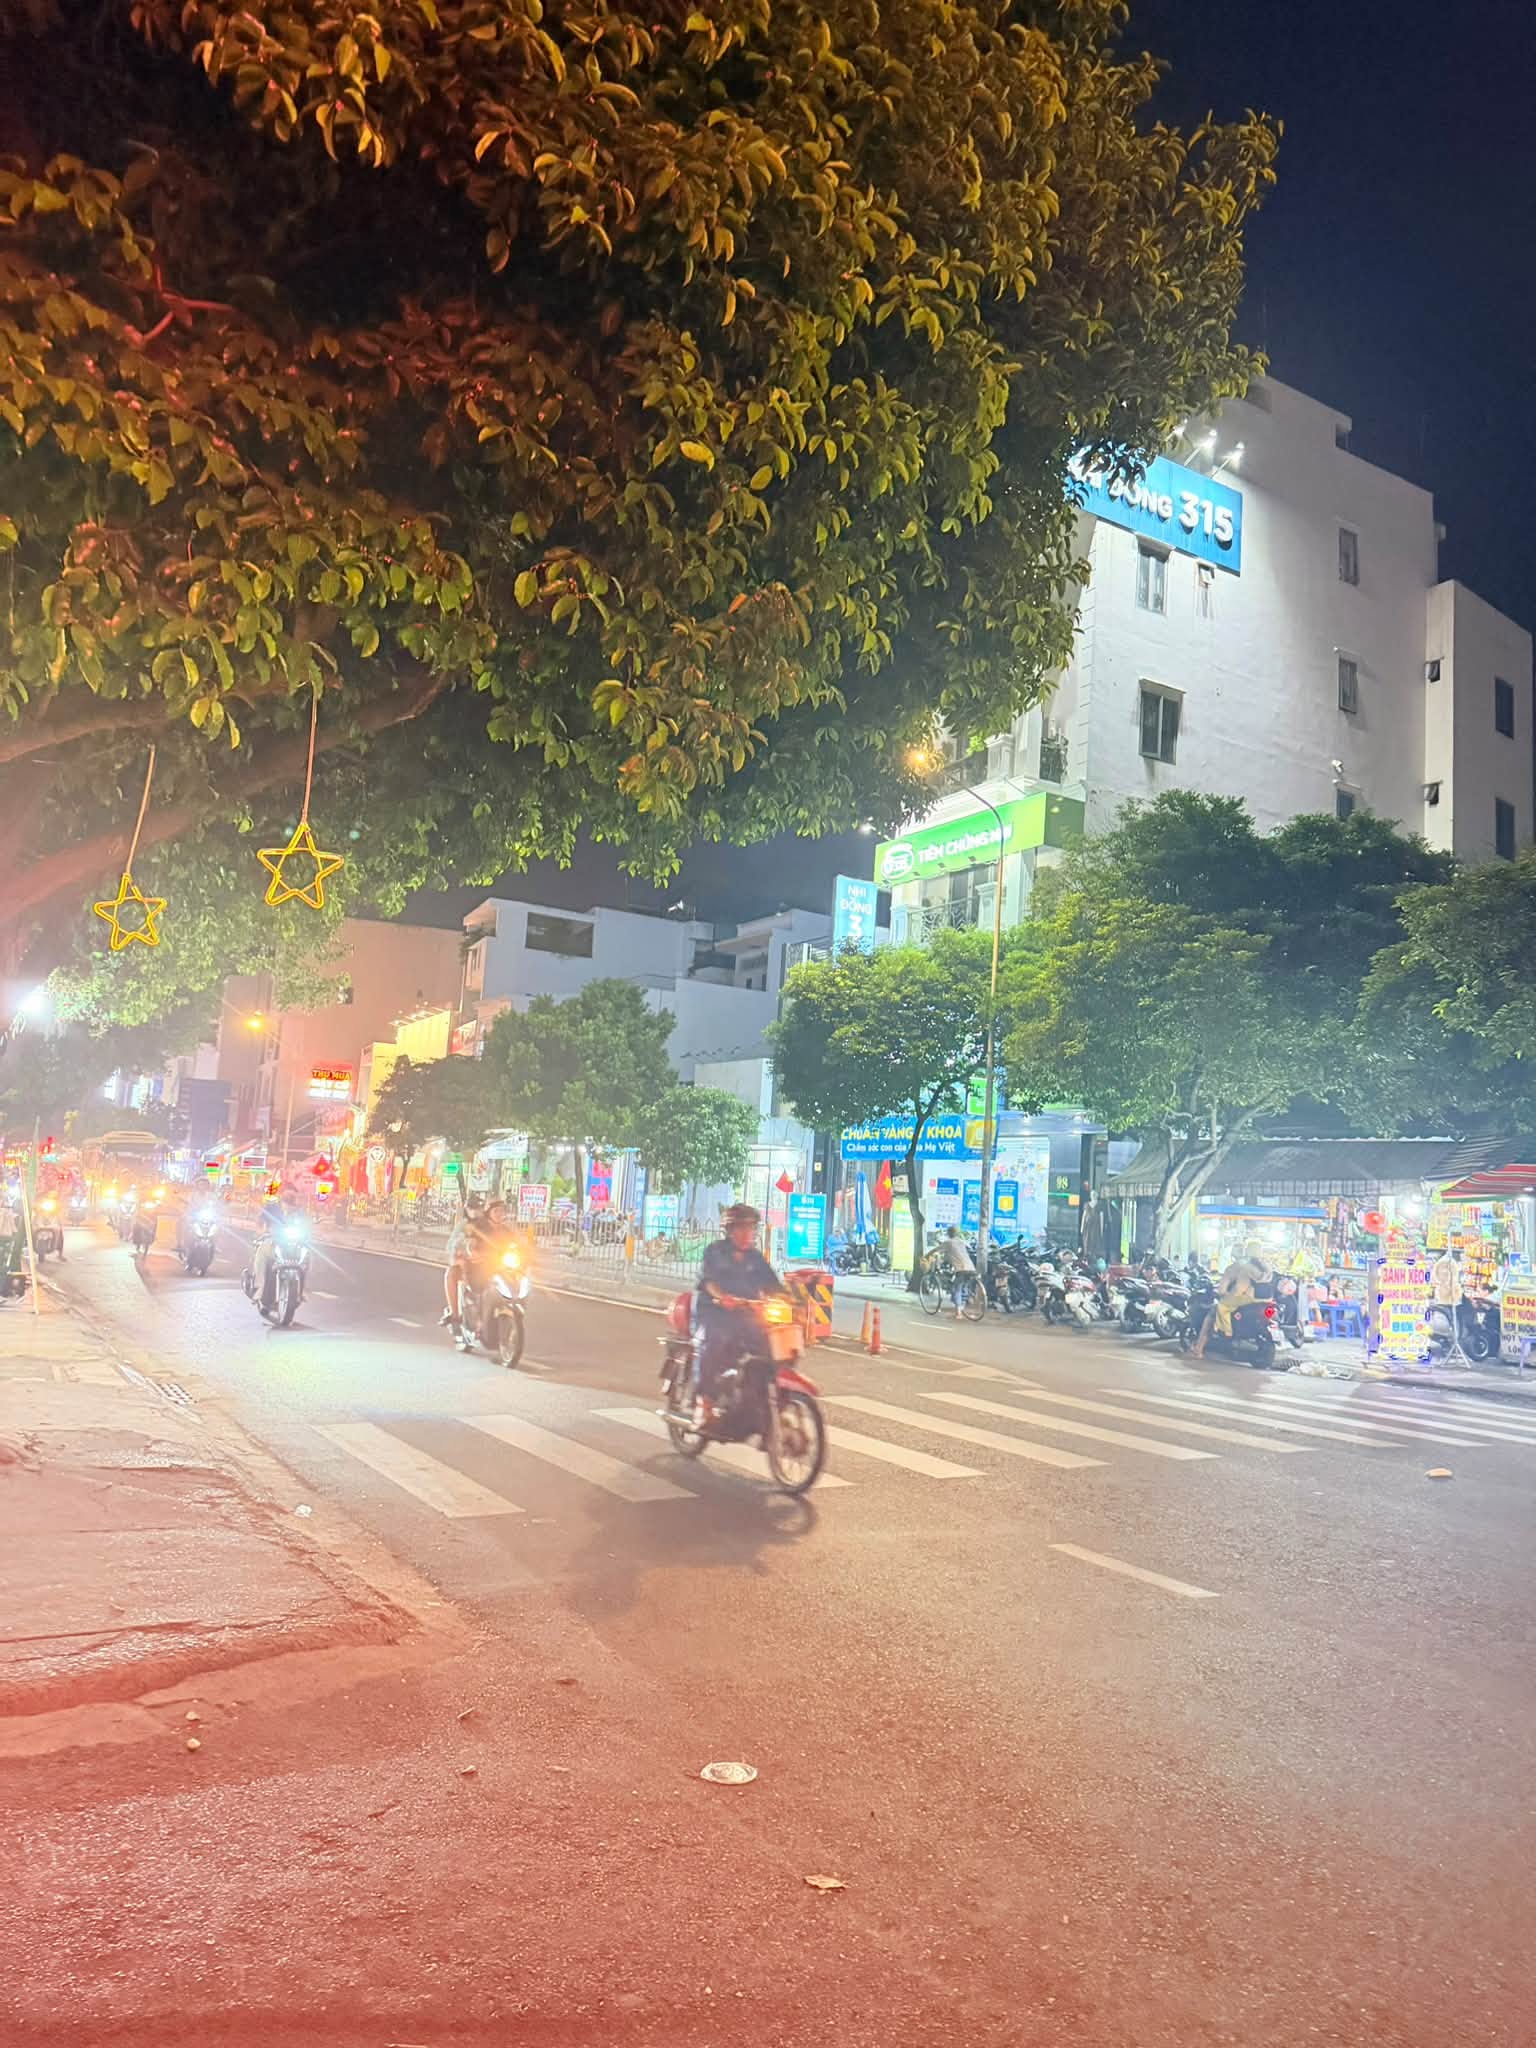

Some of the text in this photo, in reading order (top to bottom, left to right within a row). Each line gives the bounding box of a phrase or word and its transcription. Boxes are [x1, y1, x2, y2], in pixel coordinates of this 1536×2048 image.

[1179, 490, 1234, 542] 315
[848, 885, 867, 898] NHI
[848, 915, 863, 938] 3
[927, 1125, 962, 1139] KHOA
[881, 1144, 893, 1152] con
